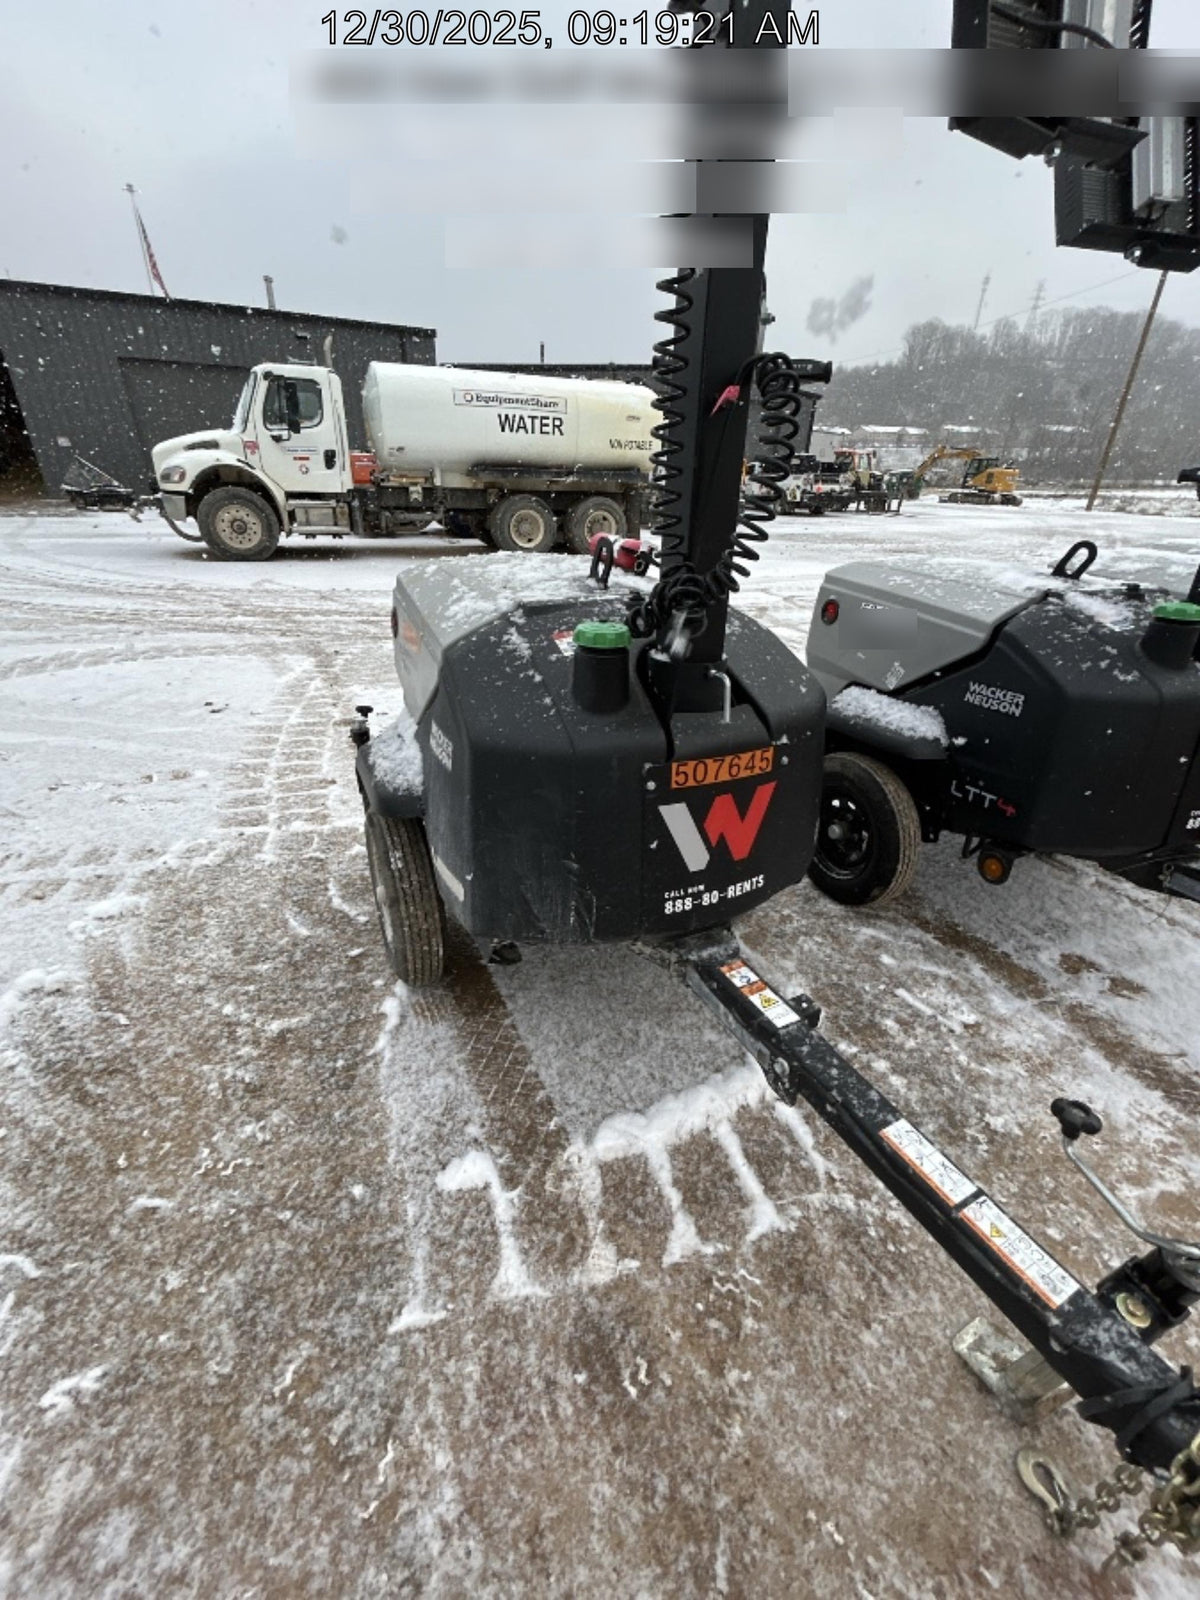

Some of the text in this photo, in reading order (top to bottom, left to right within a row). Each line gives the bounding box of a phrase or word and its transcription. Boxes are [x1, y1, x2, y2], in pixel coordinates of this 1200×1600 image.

[497, 413, 564, 436] WATER
[964, 691, 1024, 717] NEUSON
[968, 681, 1025, 705] WACKER
[674, 749, 771, 787] 507645
[664, 888, 685, 899] CALL
